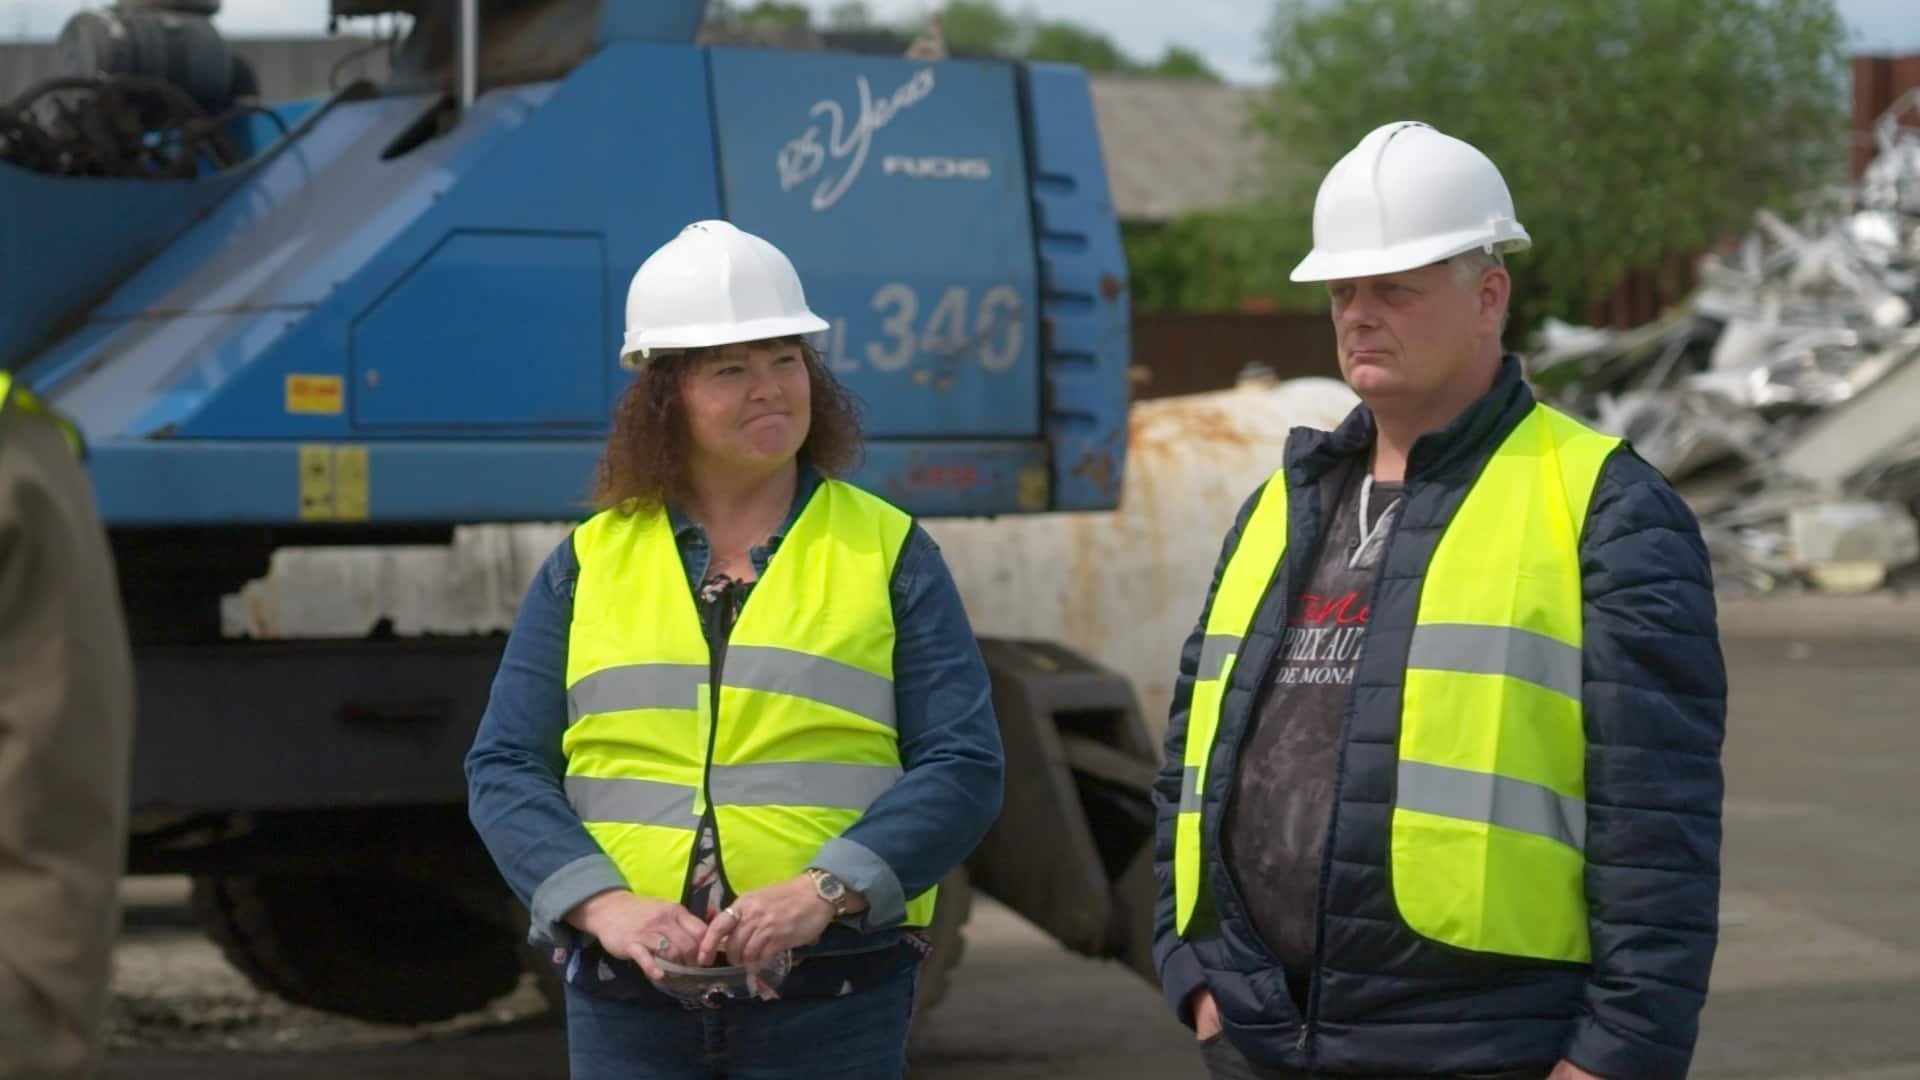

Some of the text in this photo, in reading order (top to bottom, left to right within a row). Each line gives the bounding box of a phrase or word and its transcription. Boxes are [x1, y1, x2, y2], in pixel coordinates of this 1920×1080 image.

[882, 154, 992, 180] FUCHS
[866, 281, 1024, 372] 340
[1274, 667, 1299, 684] DE
